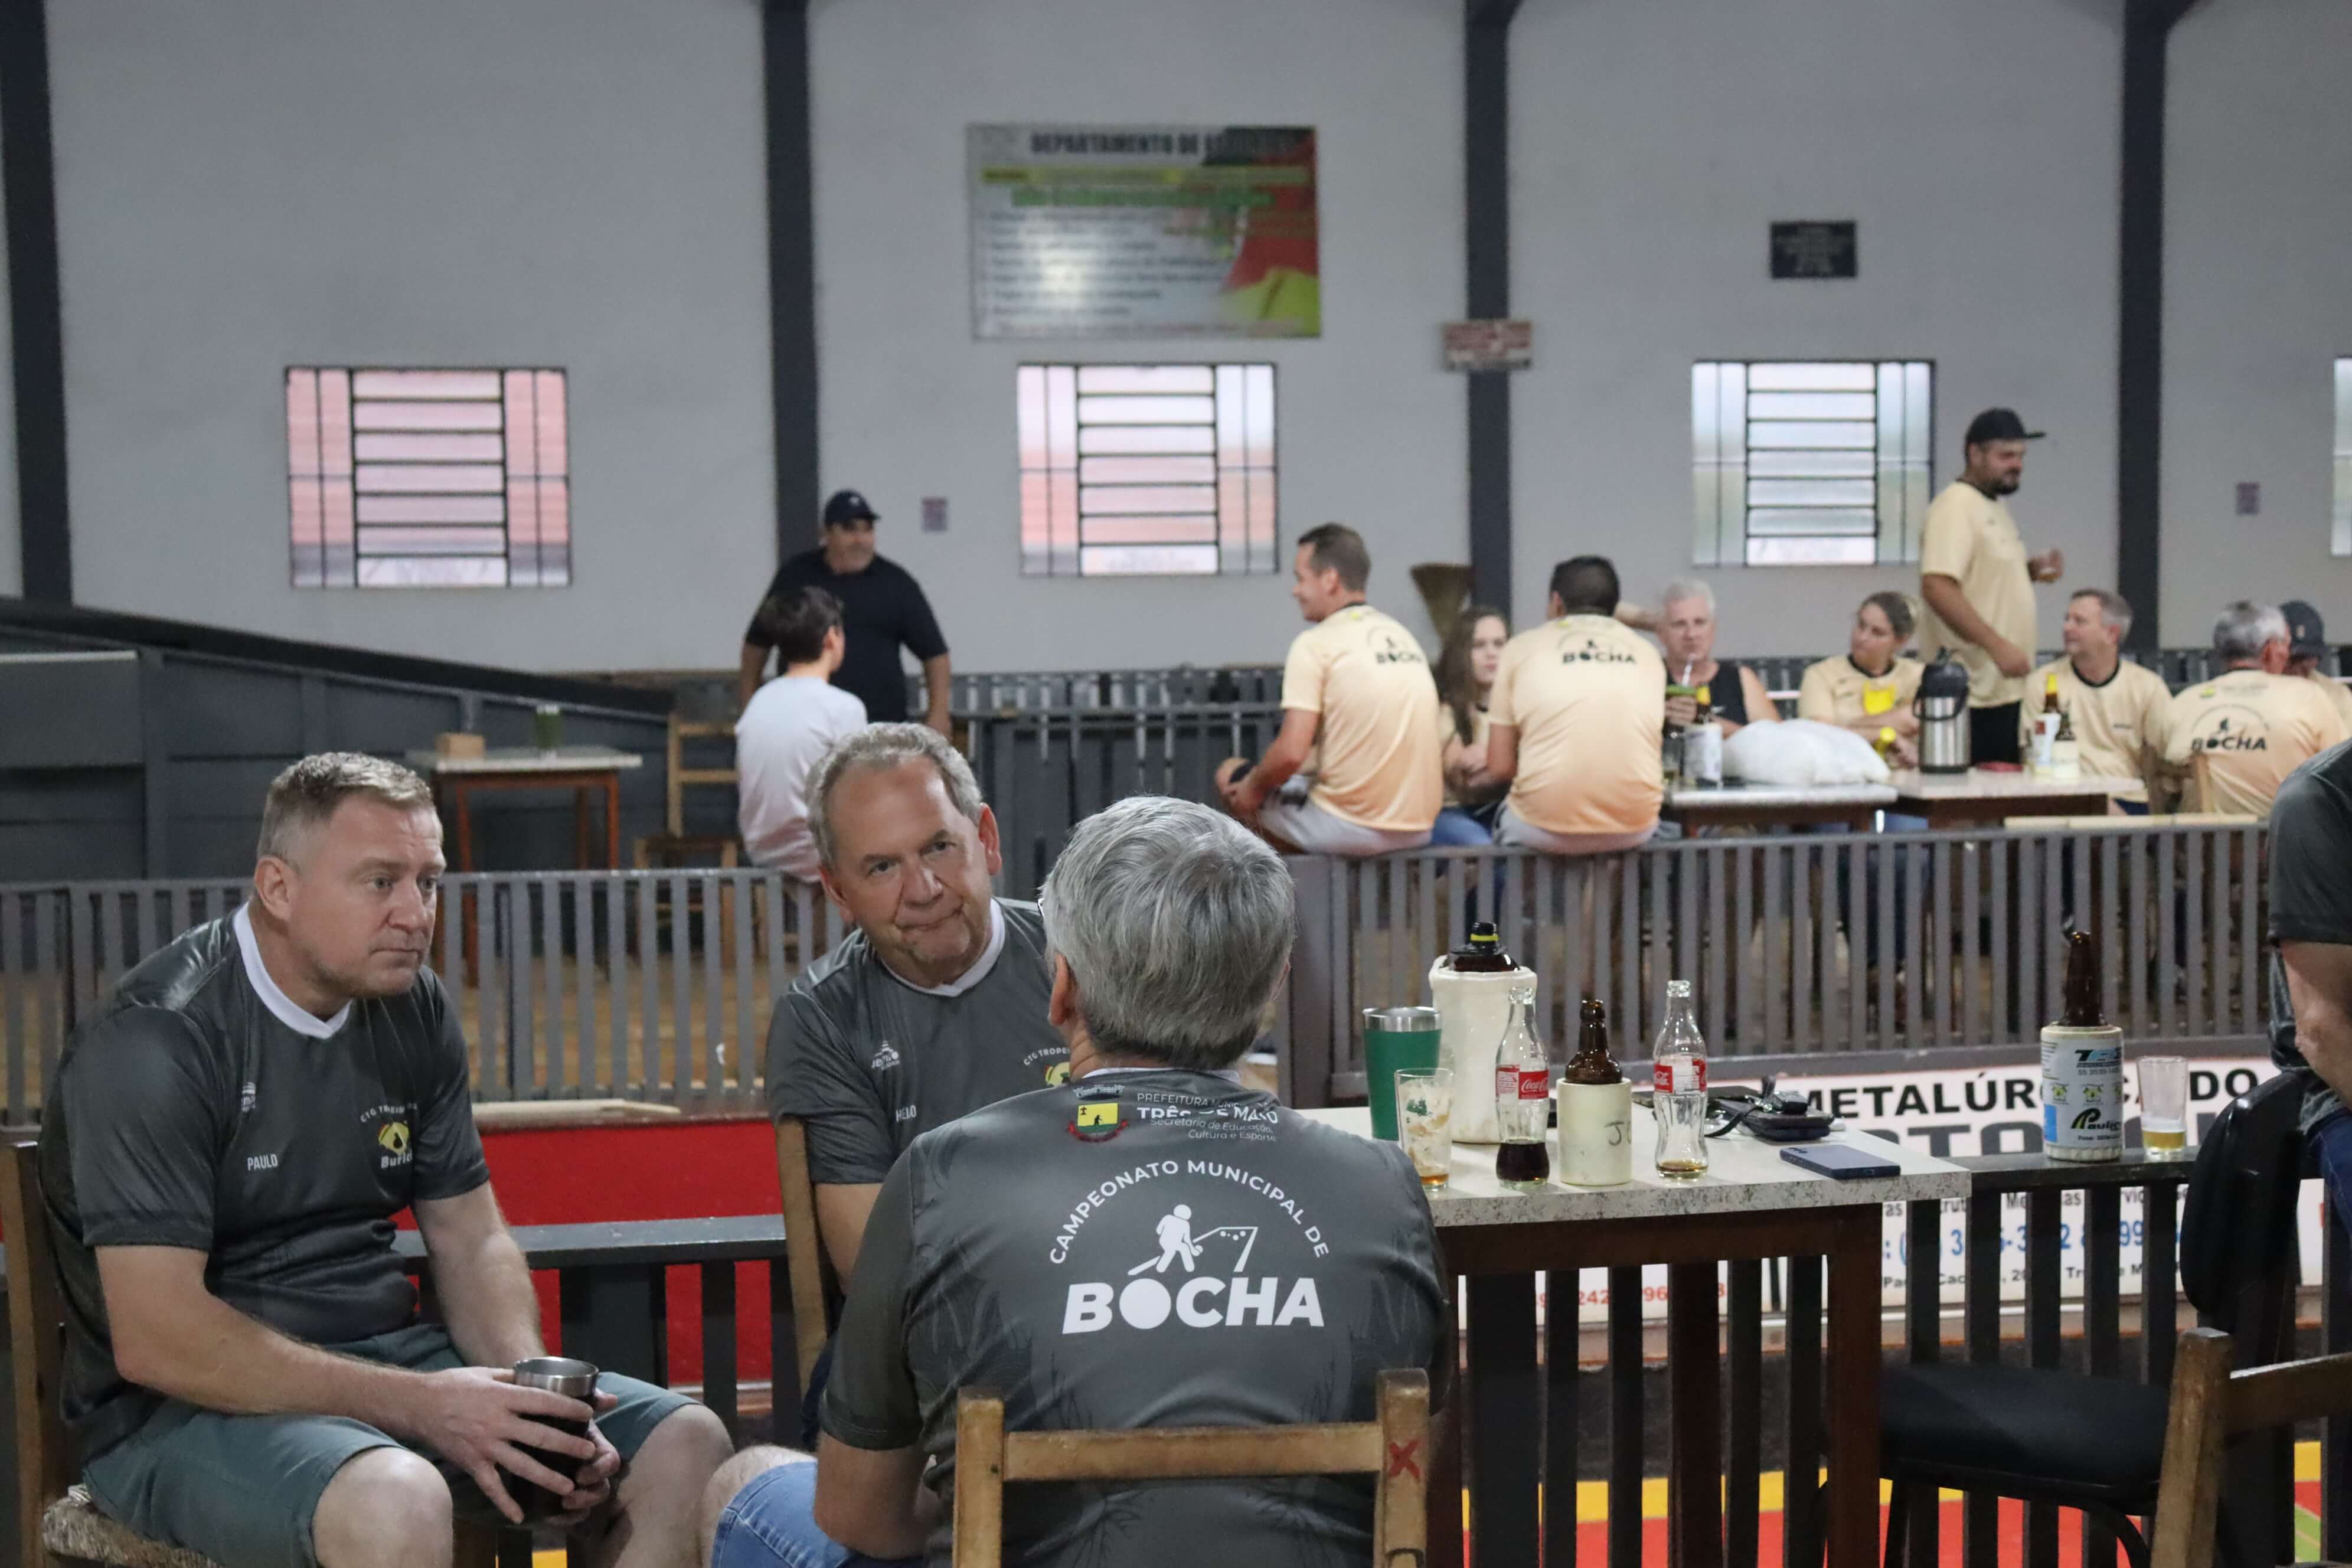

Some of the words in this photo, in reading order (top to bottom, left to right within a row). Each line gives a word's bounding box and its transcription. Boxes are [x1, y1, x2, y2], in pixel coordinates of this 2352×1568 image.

[1562, 652, 1636, 664] BOCHA
[2191, 737, 2267, 752] BOCHA
[1137, 1093, 1208, 1106] PREFEITURA
[1208, 1121, 1221, 1130] de
[1188, 1129, 1227, 1139] Cultura
[1240, 1132, 1276, 1141] Esporte
[247, 1154, 278, 1171] PAULO
[1050, 1160, 1179, 1265] CAMPEONATO
[1187, 1159, 1304, 1225] MUNICIPAL
[1304, 1226, 1329, 1259] DE
[1062, 1276, 1325, 1334] BOCHA
